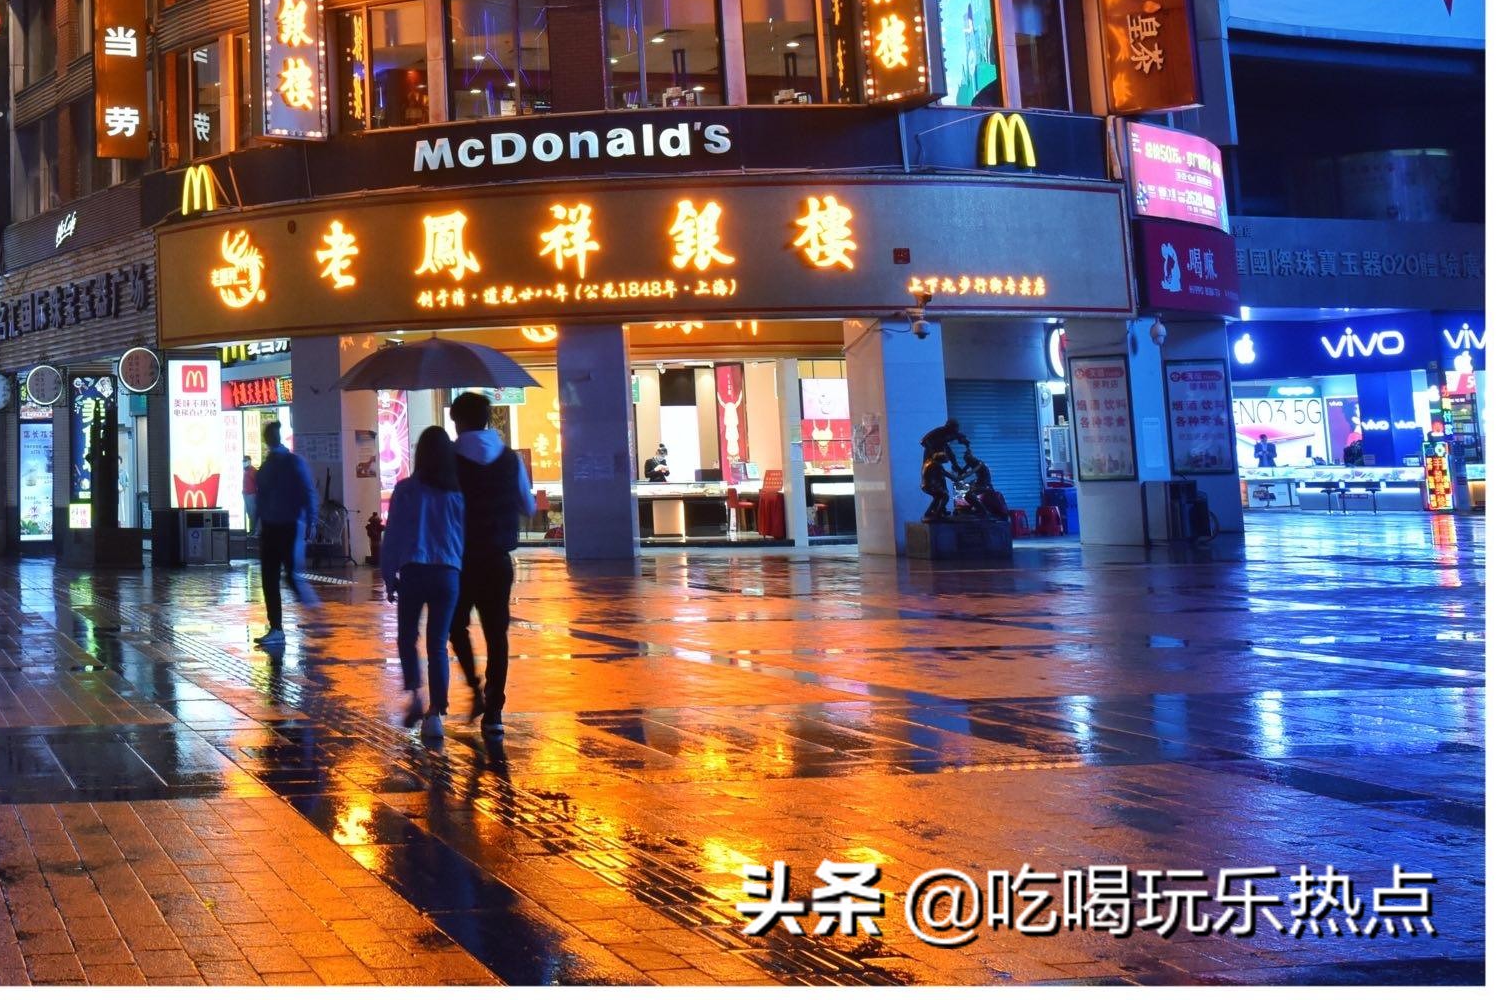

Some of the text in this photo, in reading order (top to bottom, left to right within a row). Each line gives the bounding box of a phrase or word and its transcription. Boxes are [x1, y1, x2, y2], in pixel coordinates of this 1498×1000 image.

[412, 122, 732, 172] McDonald's
[314, 194, 858, 290] 老鳳祥銀樓
[1321, 327, 1405, 358] vivo
[1295, 399, 1322, 425] 5G
